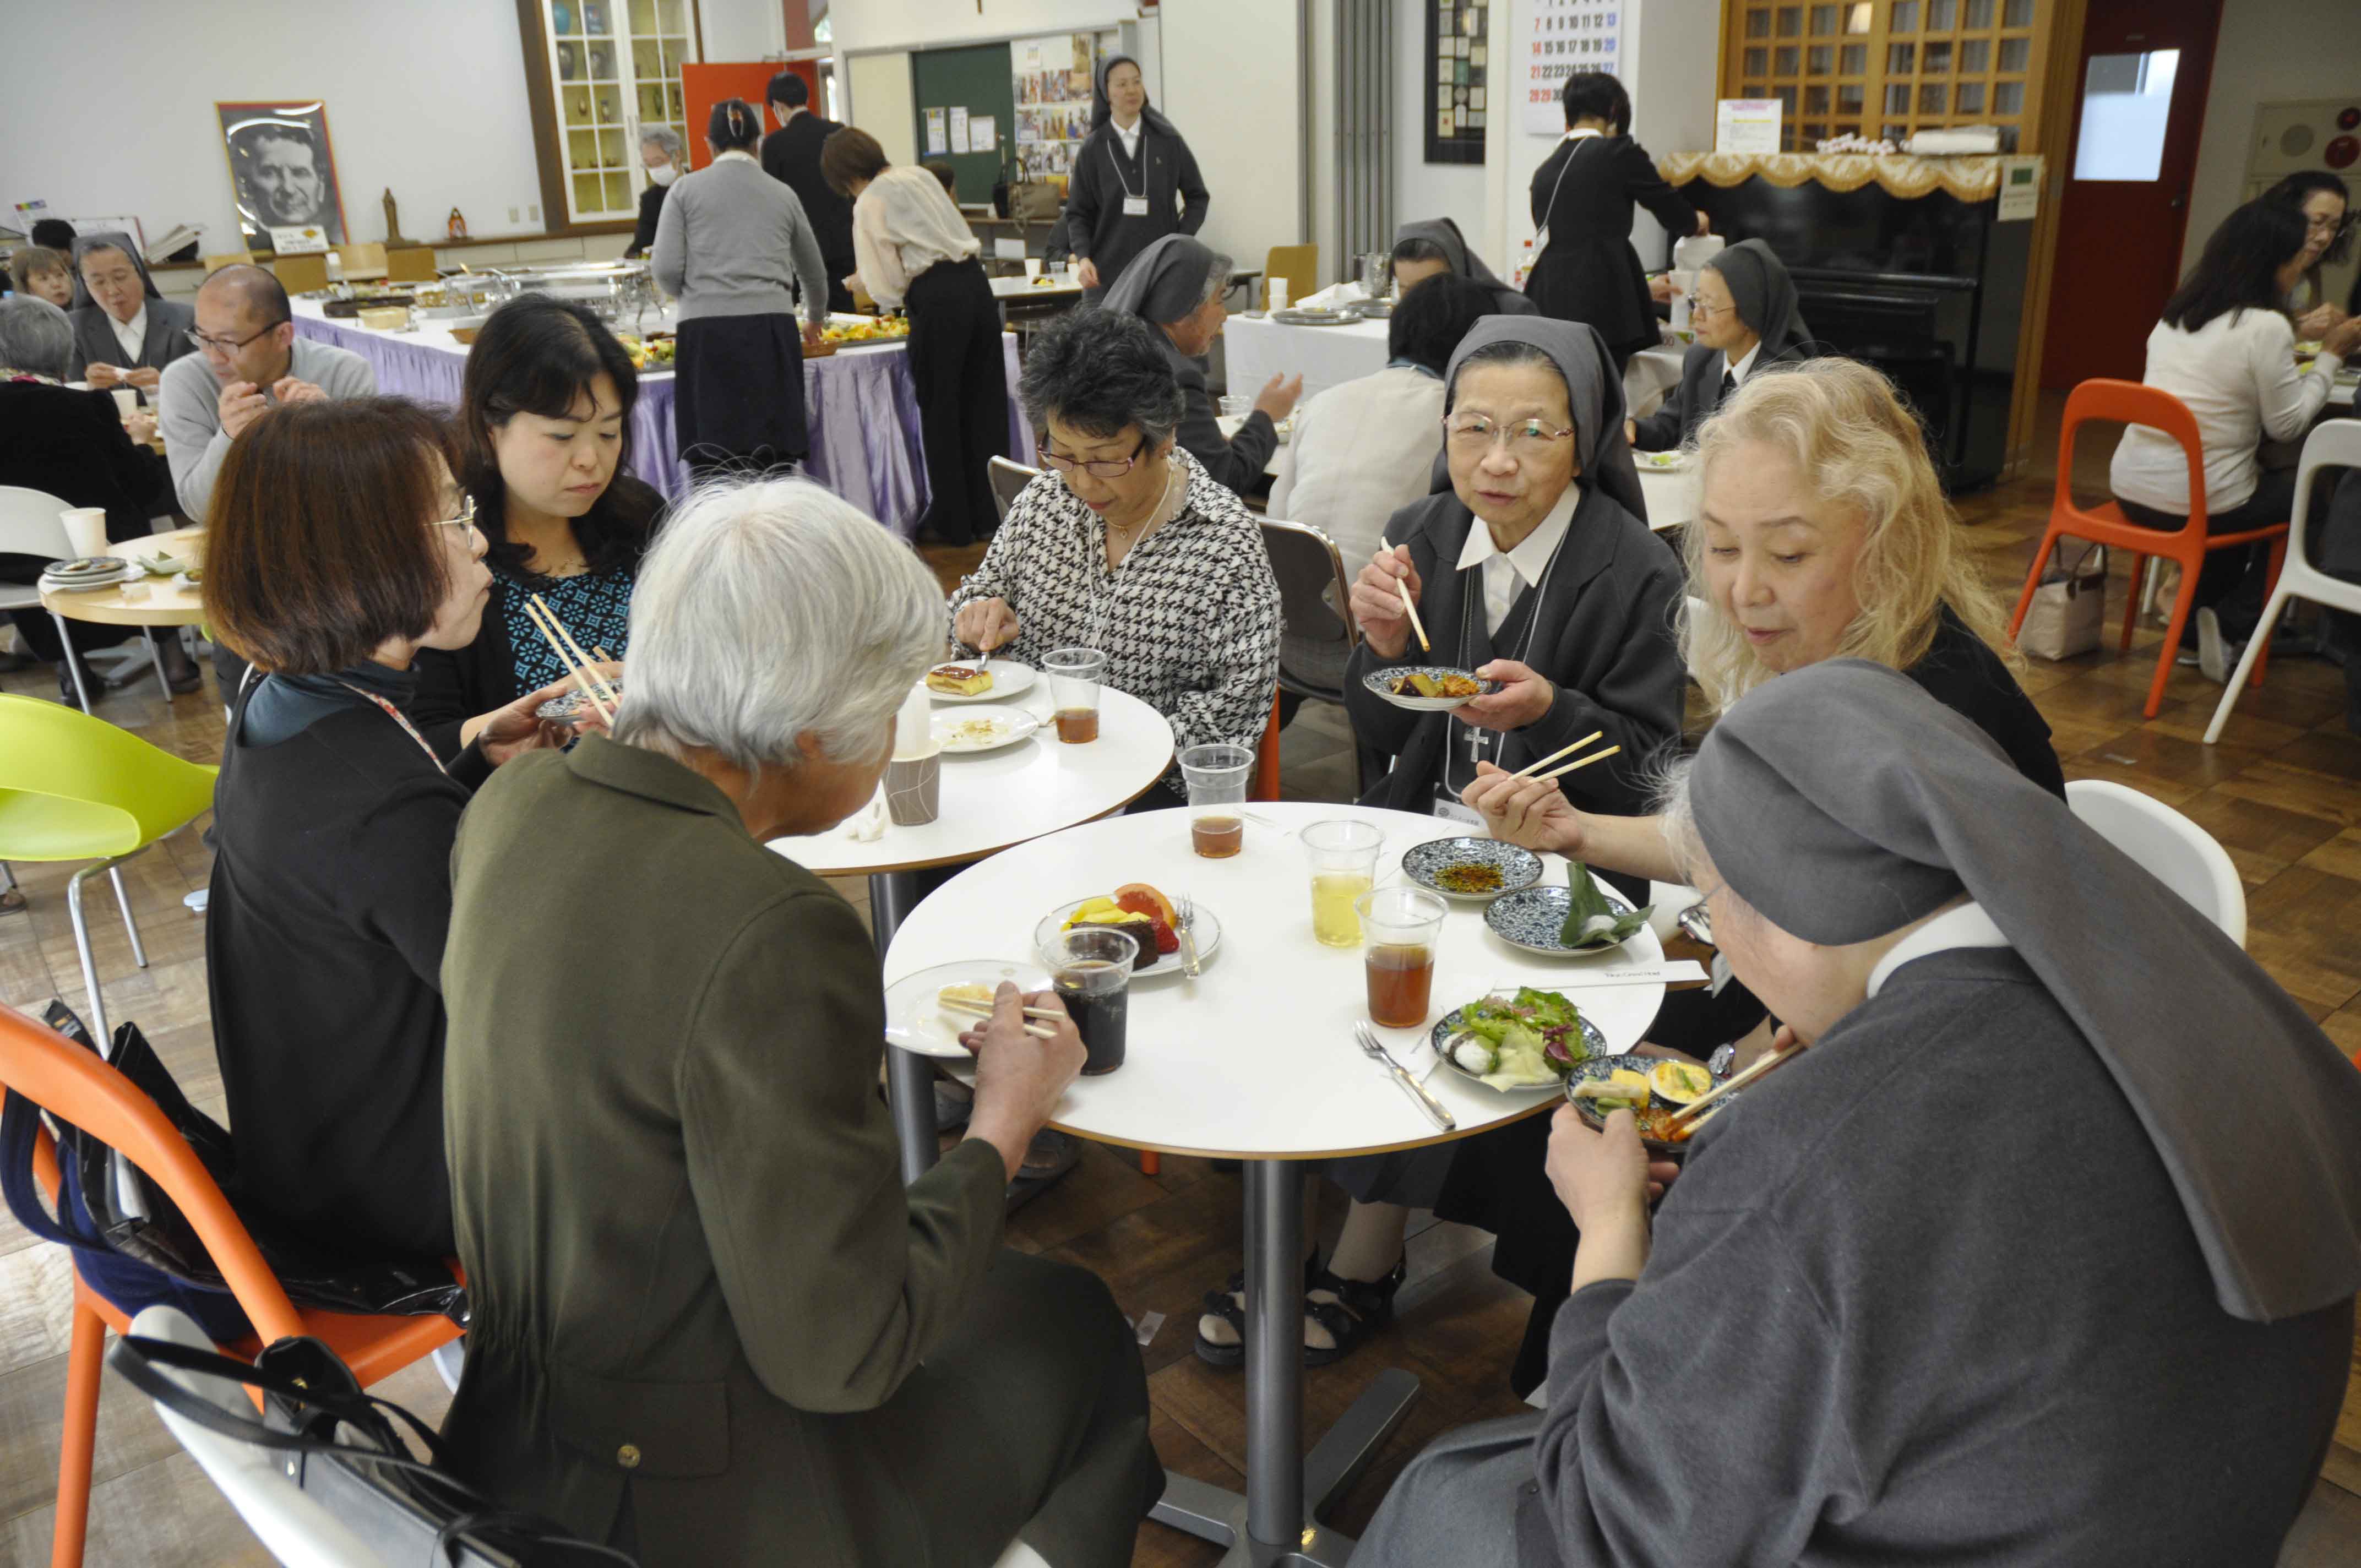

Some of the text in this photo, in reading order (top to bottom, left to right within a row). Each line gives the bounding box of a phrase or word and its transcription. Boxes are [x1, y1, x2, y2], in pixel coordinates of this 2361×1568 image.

[1569, 15, 1578, 29] 10
[1582, 14, 1590, 28] 11
[1594, 13, 1603, 28] 12
[1544, 41, 1553, 54] 15
[1557, 40, 1565, 53] 16
[1569, 40, 1577, 53] 17
[1581, 39, 1589, 53] 18
[1593, 38, 1602, 52] 19
[1531, 65, 1540, 79] 21
[1542, 65, 1552, 78] 22
[1554, 64, 1564, 78] 23
[1541, 88, 1551, 102] 29
